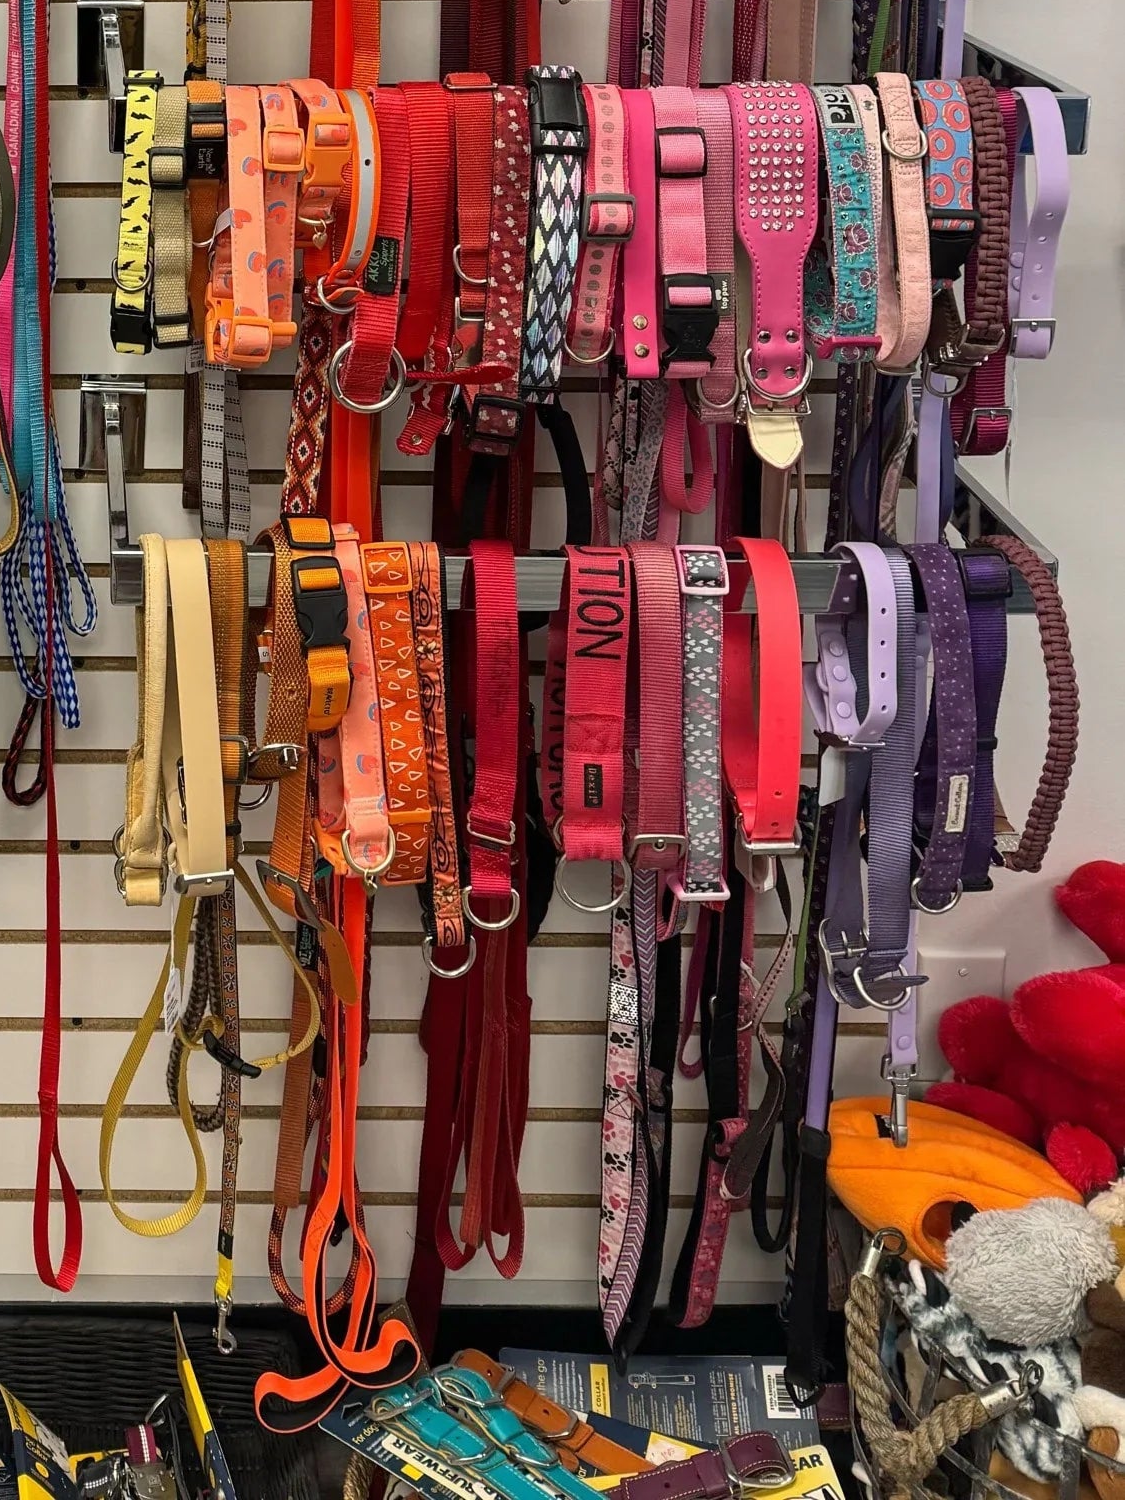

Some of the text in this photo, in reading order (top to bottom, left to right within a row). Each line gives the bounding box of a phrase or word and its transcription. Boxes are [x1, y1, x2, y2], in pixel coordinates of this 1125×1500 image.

[11, 51, 20, 93] CANINE
[9, 100, 20, 158] CANADIAN
[197, 148, 205, 169] Earth
[369, 250, 380, 282] AKKO
[379, 240, 389, 266] Sports
[720, 297, 729, 310] top
[537, 1359, 547, 1390] the go
[728, 1372, 737, 1400] PROMISE
[731, 1402, 739, 1423] TESTED
[351, 1434, 366, 1445] For
[392, 1439, 475, 1493] RUFFWEAR
